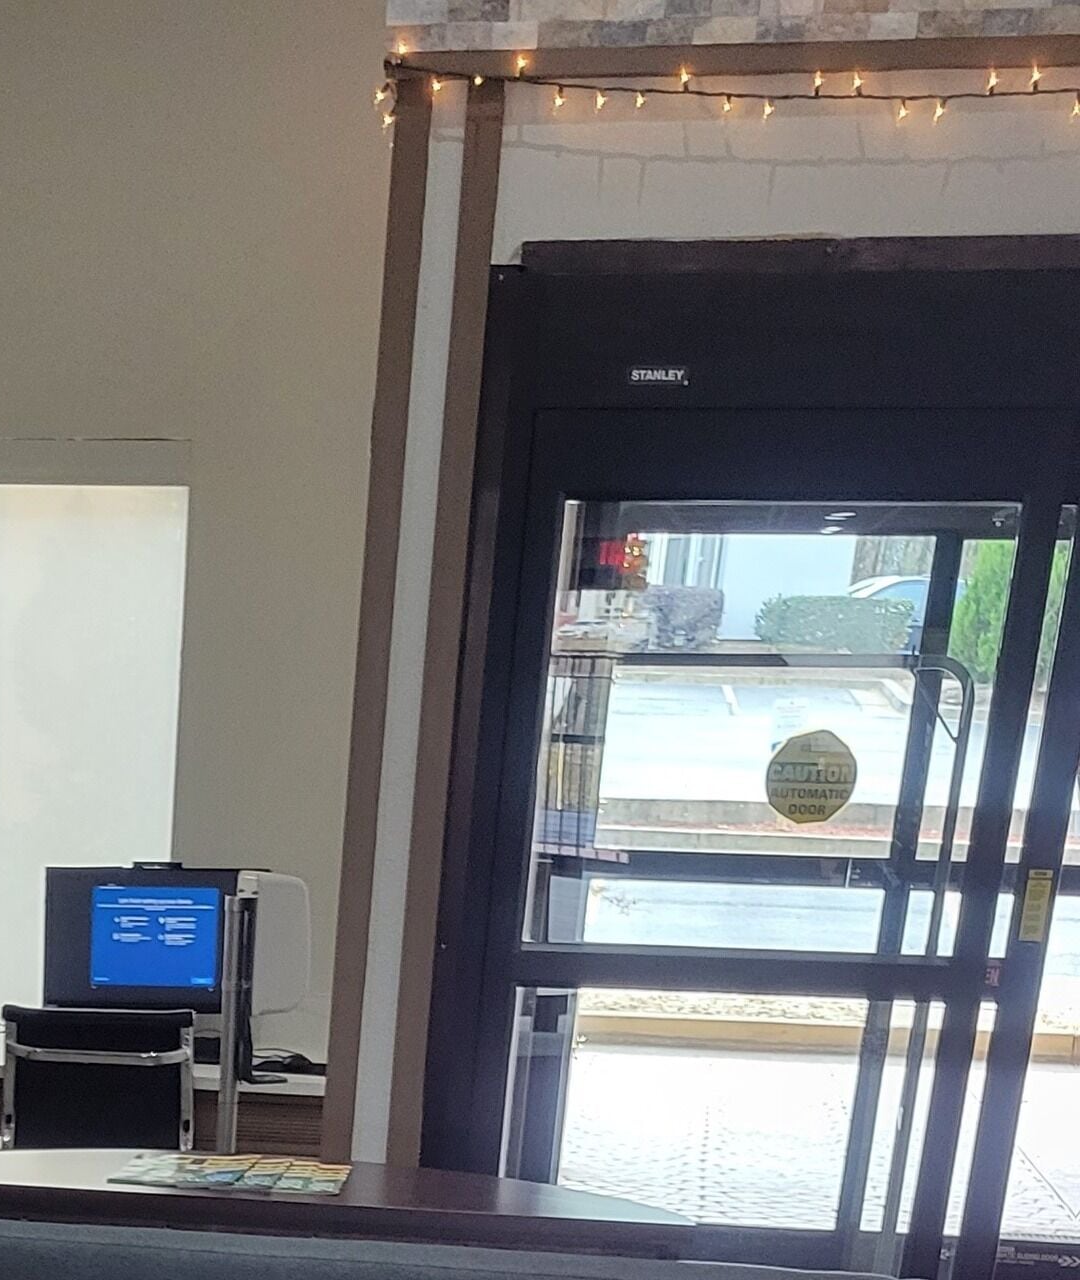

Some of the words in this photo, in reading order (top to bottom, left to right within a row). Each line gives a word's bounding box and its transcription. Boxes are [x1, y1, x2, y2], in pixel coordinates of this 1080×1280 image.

[631, 369, 684, 381] STANLEY
[770, 787, 850, 801] AUTOMATIC
[788, 803, 826, 815] DOOR
